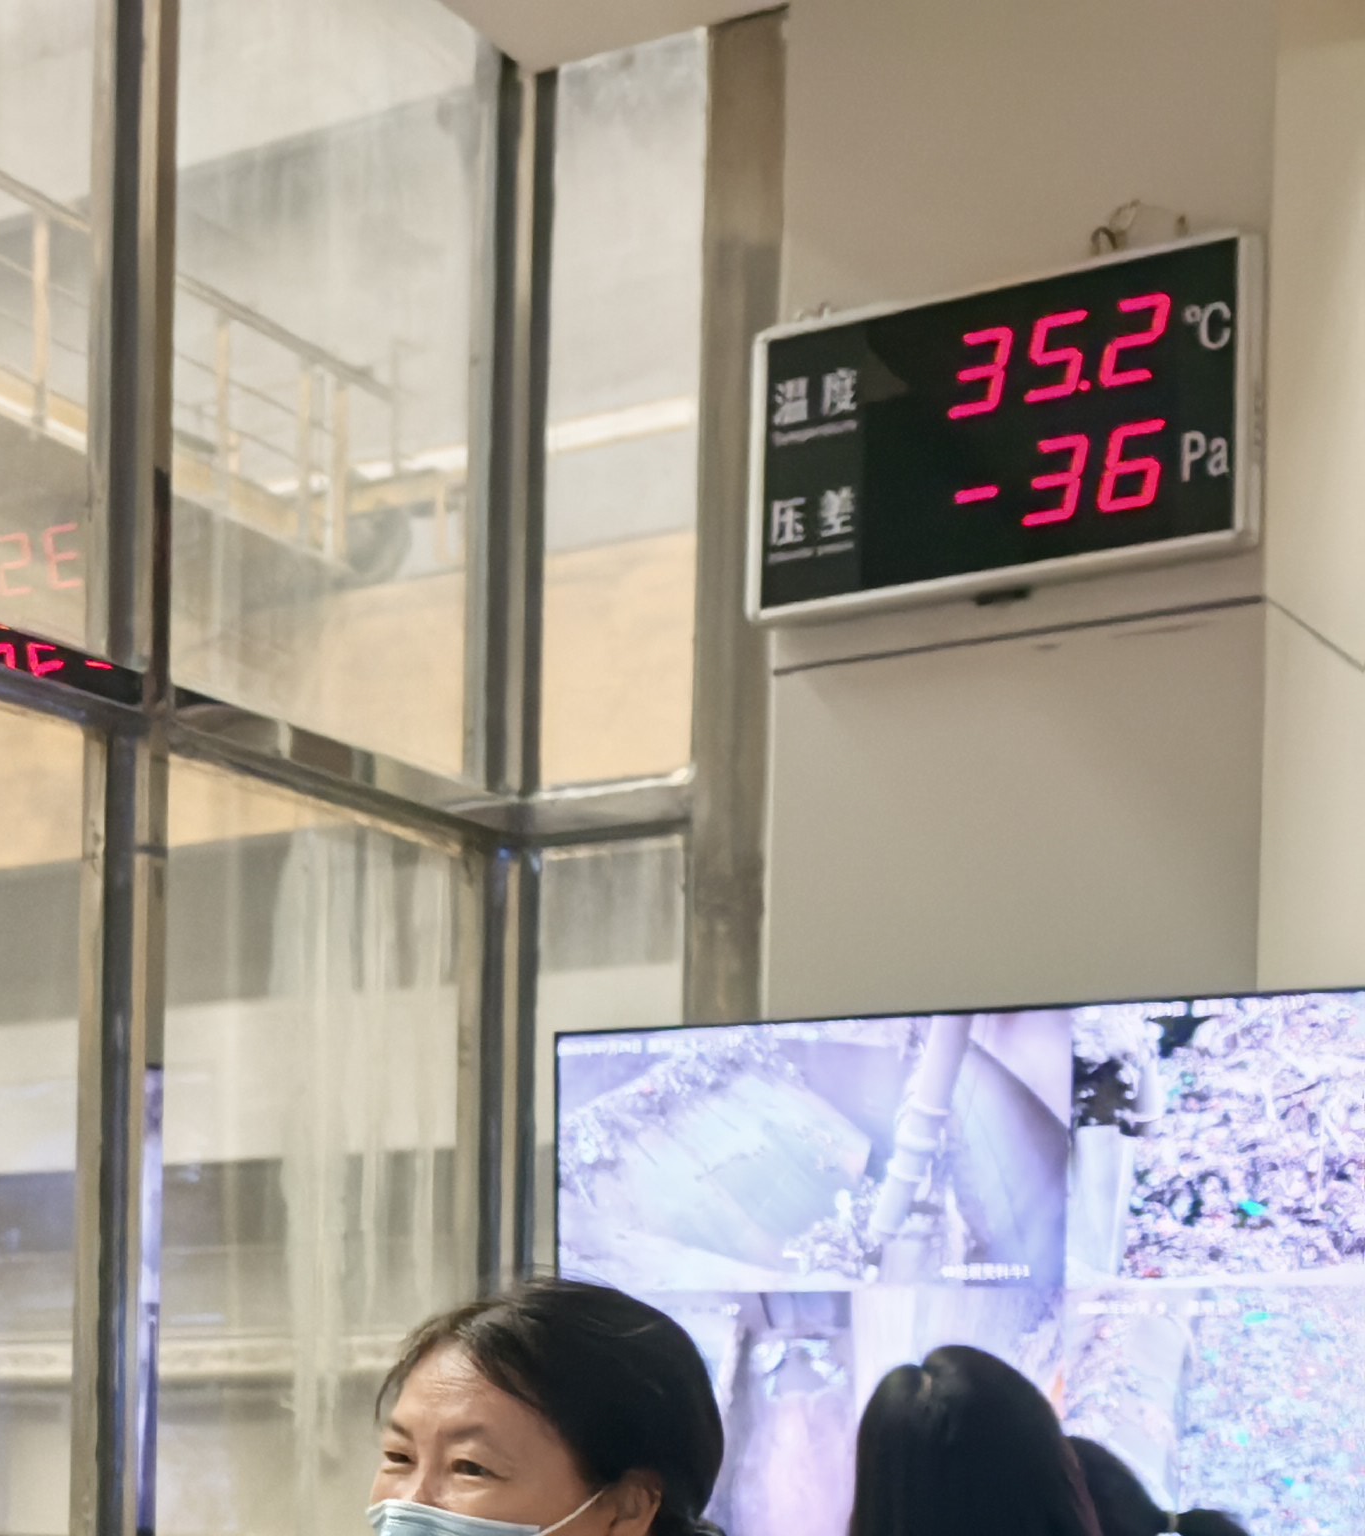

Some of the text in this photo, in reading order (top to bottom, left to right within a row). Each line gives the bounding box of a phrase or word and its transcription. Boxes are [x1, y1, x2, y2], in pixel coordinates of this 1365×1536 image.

[773, 368, 857, 426] 温度
[949, 293, 1170, 419] 35.2
[771, 486, 856, 546] 压差
[1181, 431, 1230, 481] Pa
